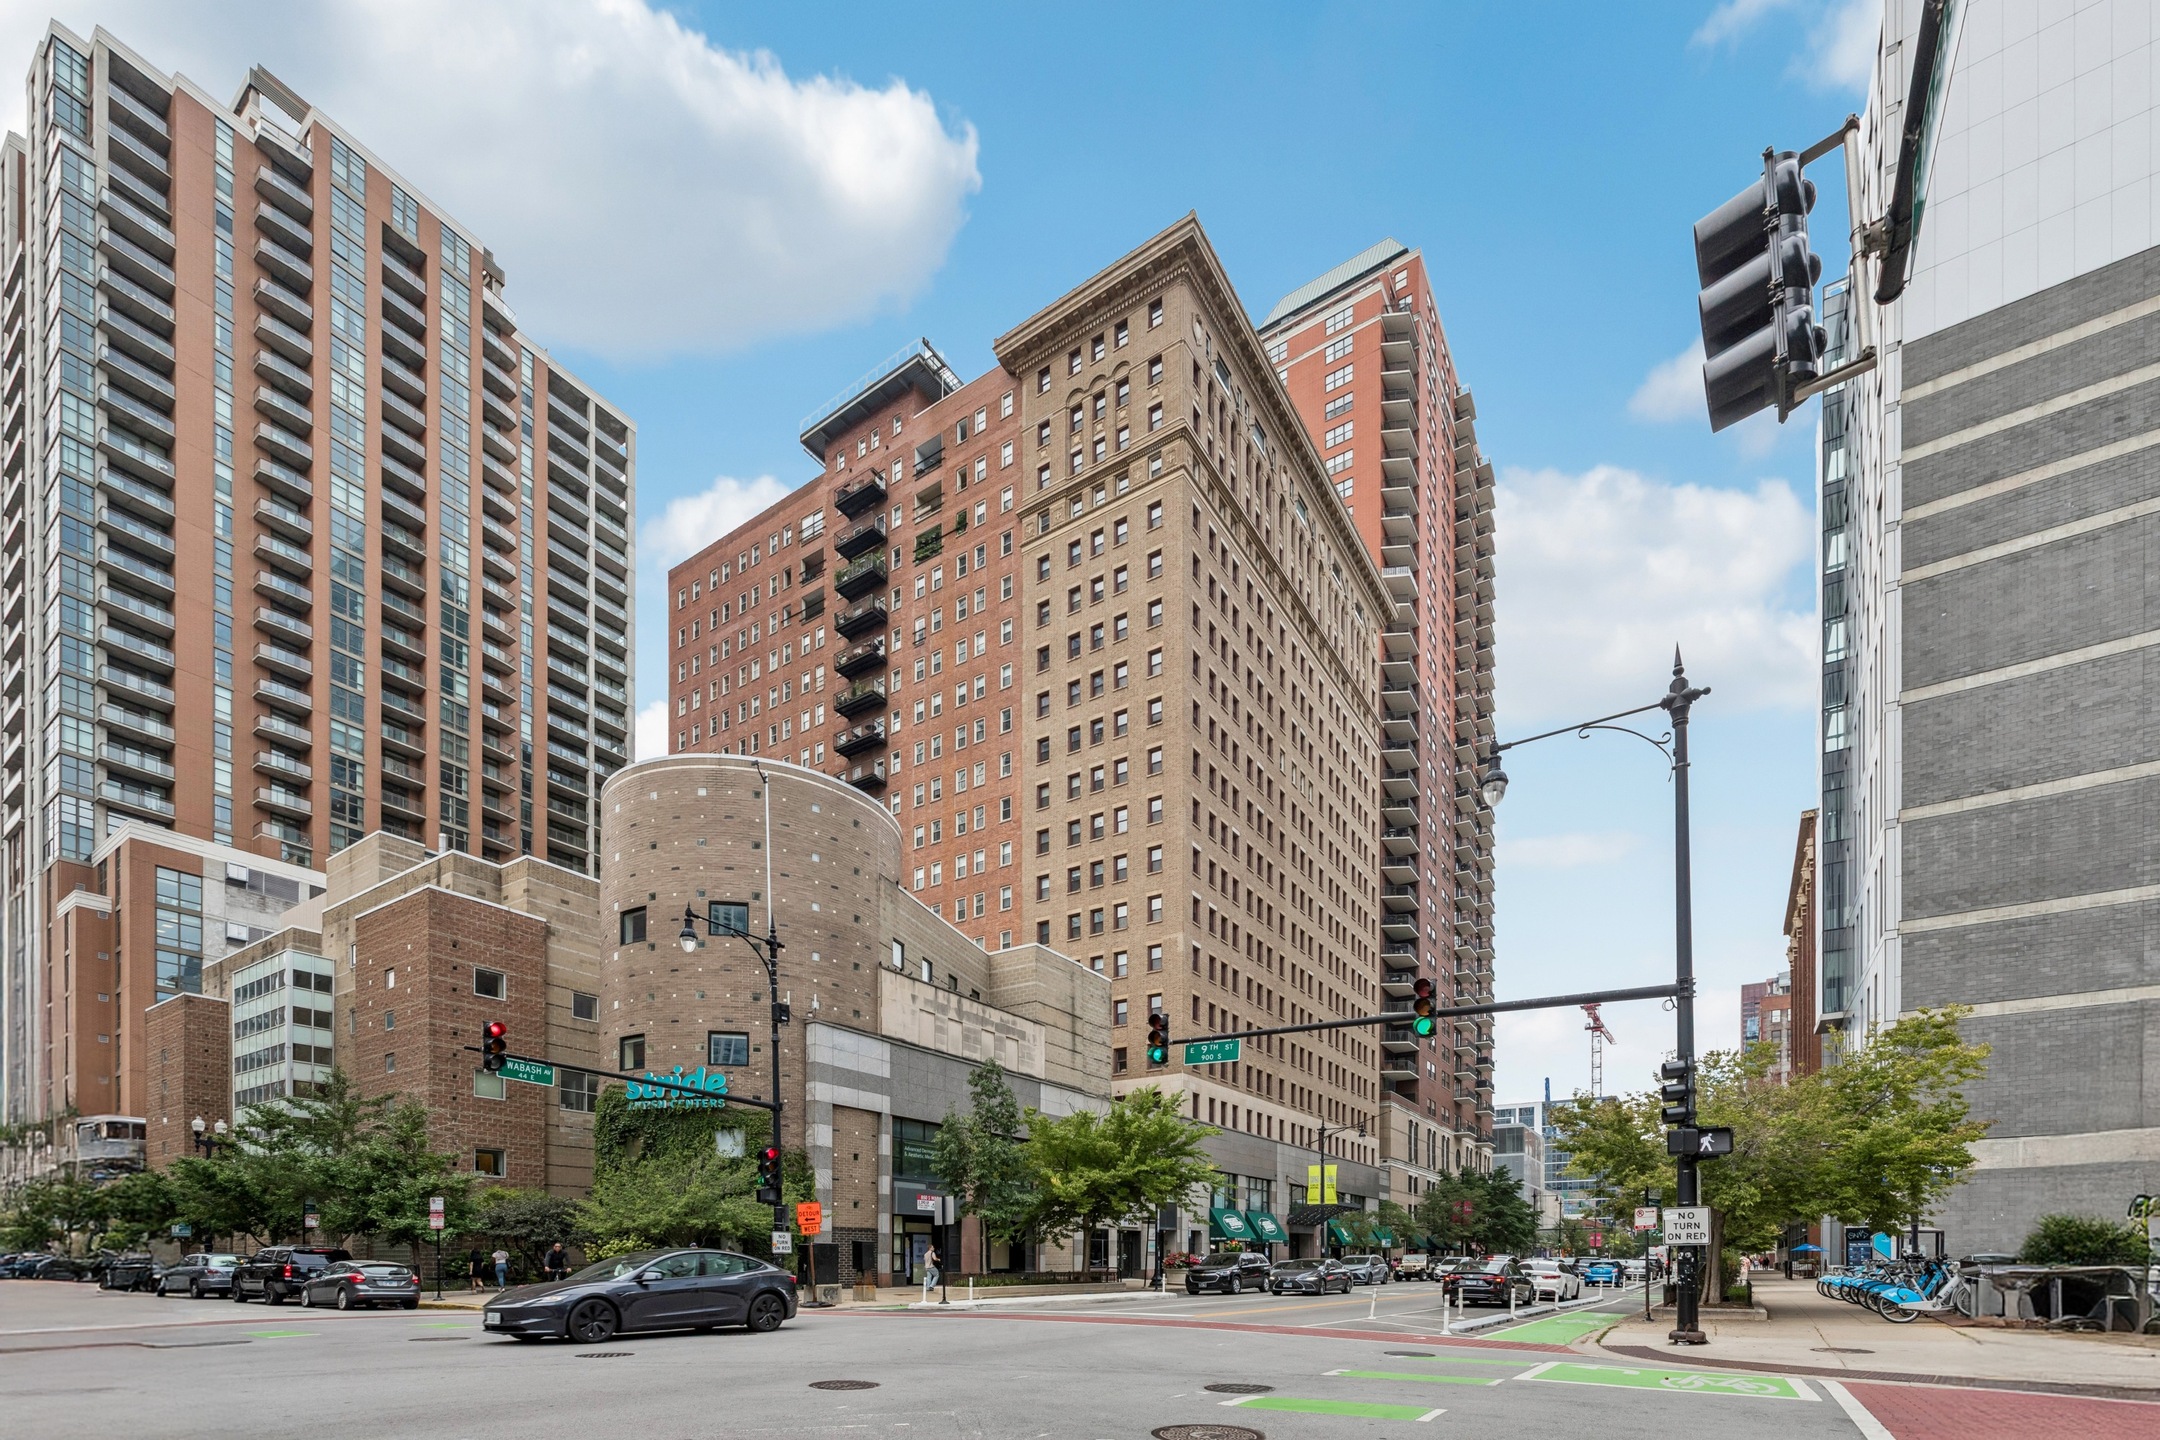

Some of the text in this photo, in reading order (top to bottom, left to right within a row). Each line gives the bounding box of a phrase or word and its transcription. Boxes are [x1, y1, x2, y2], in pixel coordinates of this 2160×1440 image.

[1201, 1044, 1219, 1054] 9TH
[1201, 1053, 1214, 1061] 900
[506, 1060, 542, 1075] WABASH
[625, 1065, 728, 1100] stride
[670, 1098, 726, 1109] CENTERS
[1673, 1222, 1700, 1230] TURN
[1686, 1232, 1706, 1240] RED
